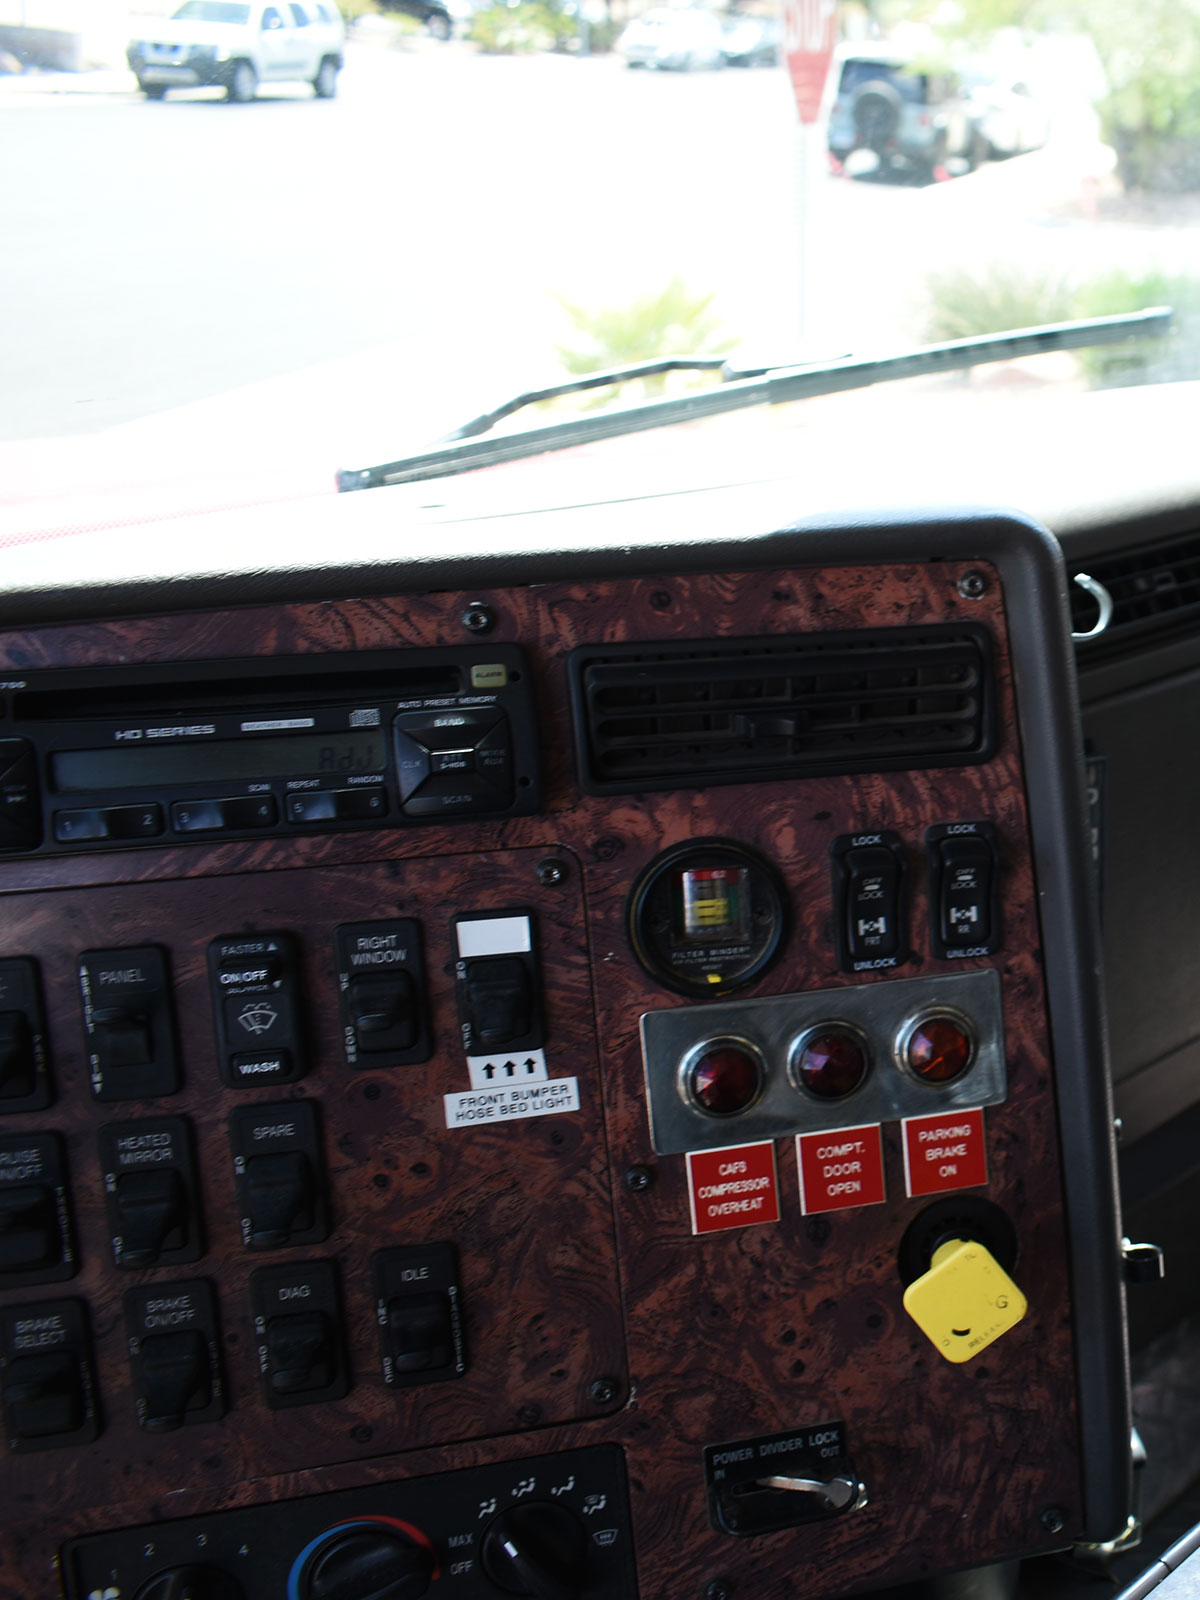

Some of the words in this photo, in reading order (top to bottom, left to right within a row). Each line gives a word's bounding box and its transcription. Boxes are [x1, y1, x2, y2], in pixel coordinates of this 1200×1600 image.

[397, 700, 422, 709] AUTO
[423, 697, 457, 707] PRESET
[458, 695, 499, 705] MEMORY
[114, 729, 143, 740] HD
[145, 724, 216, 738] SERIES
[287, 779, 320, 789] REPEAT
[347, 775, 384, 784] RANDOM
[258, 805, 268, 816] 4
[293, 803, 303, 814] 5
[63, 820, 72, 831] 1
[143, 814, 152, 825] 2
[180, 812, 189, 823] 3
[946, 824, 976, 834] LOCK
[852, 835, 882, 846] LOCK
[951, 880, 977, 890] LOCK
[857, 890, 885, 901] LOCK
[221, 943, 265, 956] FASTER
[357, 934, 398, 950] RIGHT
[350, 949, 407, 966] WINDOW
[672, 949, 705, 960] FILTER
[946, 947, 989, 959] UNLOCK
[854, 957, 897, 970] UNLOCK
[100, 968, 147, 985] PANEL
[345, 1026, 357, 1063] DOWN
[461, 1023, 472, 1050] OFF
[239, 1060, 280, 1075] WASH
[458, 1092, 506, 1109] FRONT
[511, 1084, 569, 1101] BUMPER
[455, 1106, 495, 1121] HOSE
[500, 1101, 529, 1115] BED
[533, 1095, 573, 1110] LIGHT
[253, 1122, 296, 1141] SPARE
[919, 1124, 972, 1143] PARKING
[117, 1132, 172, 1150] HEATED
[119, 1148, 174, 1166] MIRROR
[817, 1141, 866, 1160] COMPT.
[925, 1144, 967, 1161] BRAKE
[718, 1160, 747, 1177] CAFS
[823, 1161, 862, 1178] DOOR
[938, 1164, 957, 1178] ON
[698, 1176, 770, 1200] COMPRESSOR
[827, 1180, 861, 1197] OPEN
[708, 1197, 764, 1217] OVERHEAT
[241, 1216, 252, 1245] OFF
[401, 1266, 430, 1282] IDLE
[278, 1284, 311, 1301] DIAG
[146, 1295, 191, 1313] BRAKE
[15, 1315, 63, 1334] BRAKE
[14, 1329, 67, 1349] SELECT
[258, 1345, 269, 1374] OFF
[712, 1446, 754, 1467] POWER
[759, 1437, 804, 1457] DIVIDER
[808, 1429, 840, 1447] LOCK
[820, 1445, 840, 1459] OUT
[714, 1468, 726, 1481] IN
[197, 1533, 208, 1548] 3
[448, 1532, 473, 1549] MAX
[143, 1542, 155, 1558] 2
[238, 1543, 249, 1557] 4
[110, 1567, 119, 1581] 1
[450, 1560, 473, 1575] OFF
